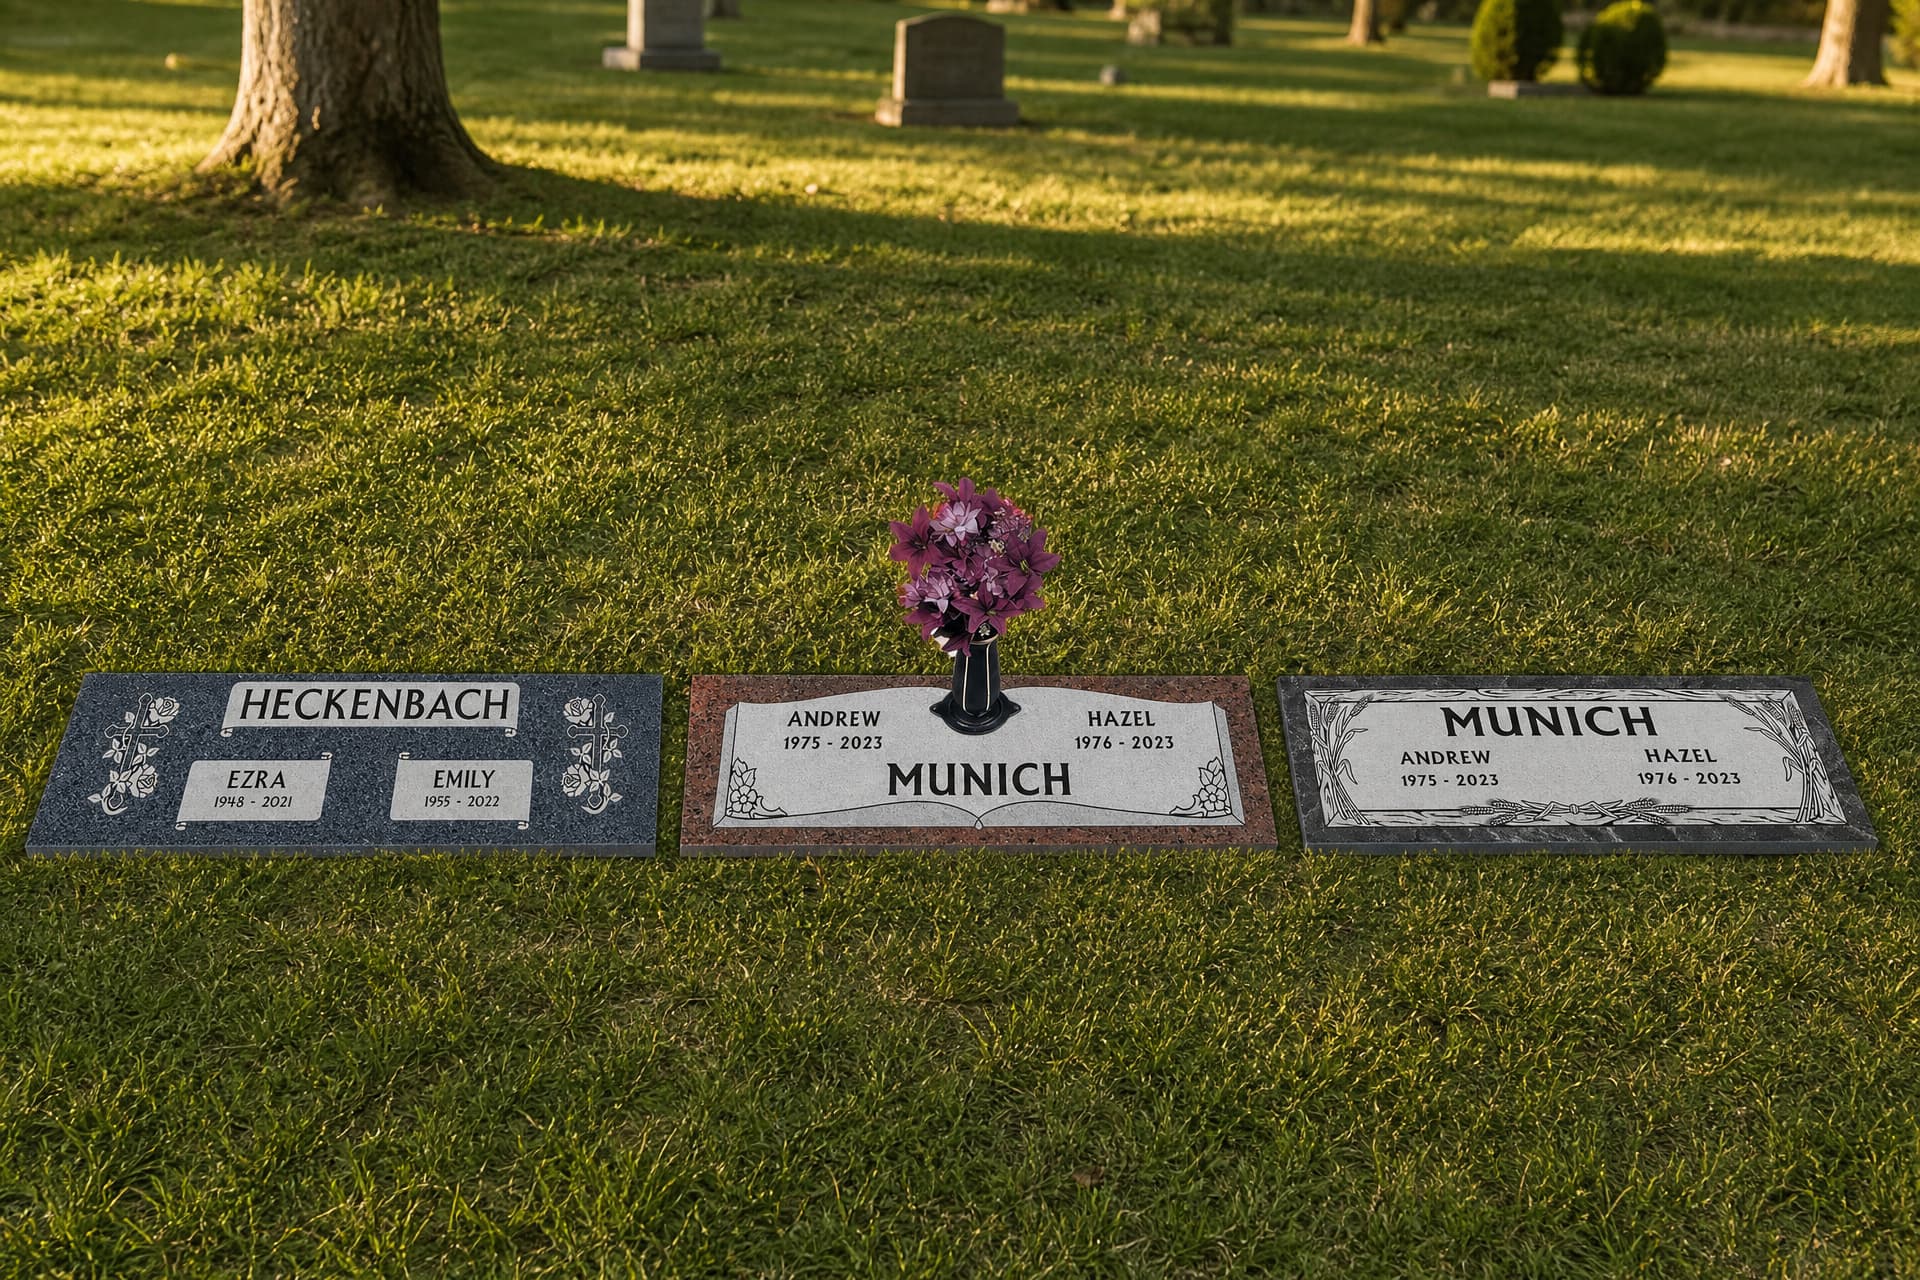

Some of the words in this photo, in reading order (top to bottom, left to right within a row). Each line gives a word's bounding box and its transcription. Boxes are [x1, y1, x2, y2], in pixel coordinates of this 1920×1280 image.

[239, 688, 510, 721] HECKENBACH
[786, 710, 881, 728] ANDREW
[1087, 710, 1156, 727] HAZEL
[1439, 705, 1659, 737] MUNICH
[783, 735, 821, 750] 1975
[839, 735, 883, 750] 2023
[1074, 735, 1113, 750] 1976
[1131, 735, 1174, 750] 2023
[1400, 749, 1491, 766] ANDREW
[1643, 748, 1718, 763] HAZEL
[226, 769, 286, 789] EZRA
[433, 769, 496, 789] EMILY
[886, 762, 1072, 797] MUNICH
[1400, 774, 1438, 787] 1975
[1455, 773, 1499, 787] 2023
[1636, 771, 1678, 785] 1976
[1695, 771, 1741, 785] 2023
[213, 795, 245, 808] 1948
[261, 795, 293, 808] 2021
[424, 795, 451, 808] 1955
[467, 794, 500, 808] 2022
